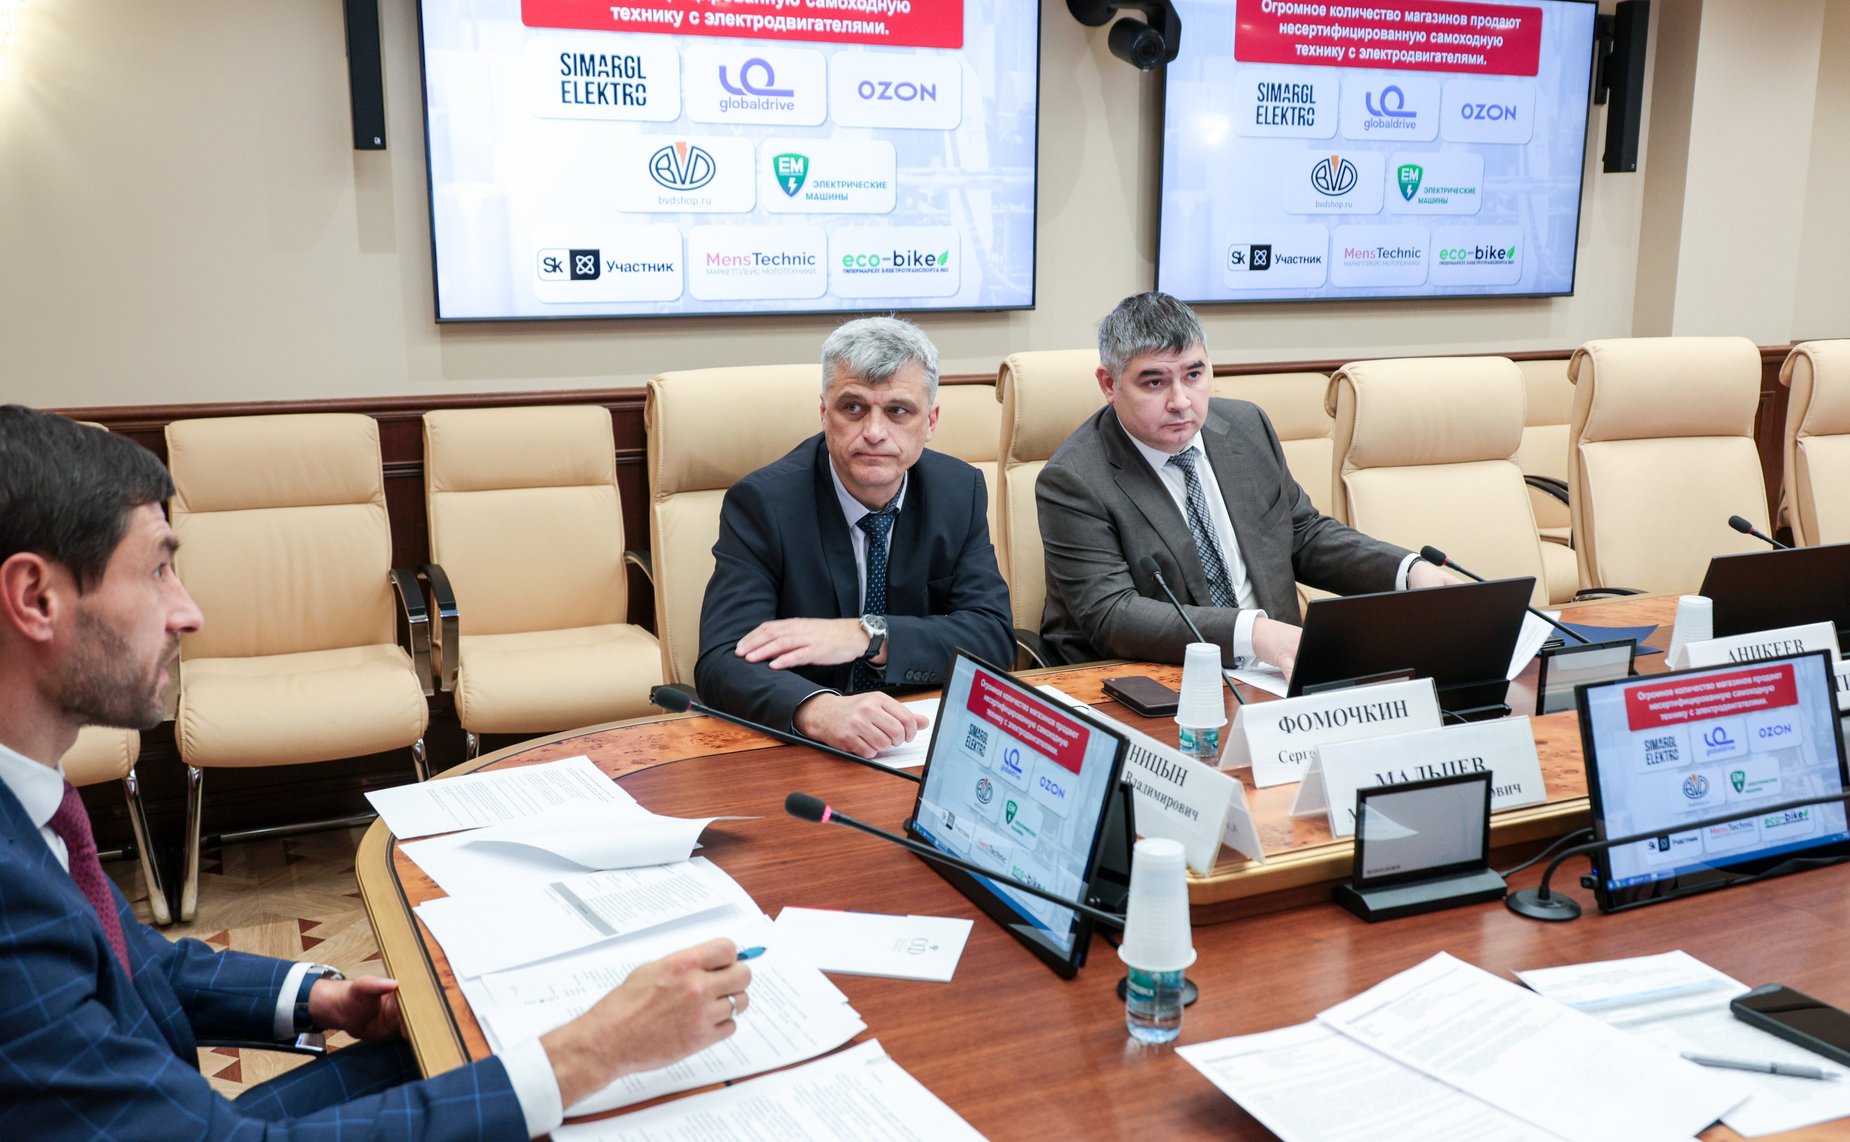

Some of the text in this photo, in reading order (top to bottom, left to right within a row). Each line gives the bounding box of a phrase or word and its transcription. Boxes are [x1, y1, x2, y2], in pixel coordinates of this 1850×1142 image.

[610, 6, 890, 35] технику с электродвигателями.
[1262, 0, 1521, 30] Огромное количество магазинов продают
[1279, 22, 1503, 48] несертифицированную самоходную
[1295, 43, 1487, 66] технику с электродвигателями.
[560, 52, 647, 79] SIMARGL
[561, 80, 647, 106] ELEKTRO
[858, 80, 936, 101] OZON
[1257, 82, 1316, 104] SIMARGL
[719, 97, 795, 112] globaldrive
[1461, 103, 1517, 121] OZON
[1256, 105, 1315, 126] ELEKTRO
[1364, 118, 1417, 131] globaldrive
[649, 145, 716, 190] BVD
[812, 180, 888, 189] ЭЛЕКТРИЧЕСКИЕ
[1311, 158, 1358, 196] BVD
[805, 192, 849, 201] МАШИНЫ
[1423, 187, 1476, 195] ЭЛЕКТРИЧЕСКИЕ
[658, 196, 712, 206] bvdshop.ru
[1315, 200, 1353, 209] bvdshop.ru
[1417, 197, 1449, 205] МАШИНЫ
[706, 252, 816, 266] MensTechnic
[842, 250, 936, 267] eco-bike
[1231, 252, 1246, 265] Sk
[1274, 254, 1322, 266] Участник
[1344, 247, 1421, 259] MensTechnic
[1439, 245, 1506, 260] eco-bike
[543, 257, 564, 273] Sk
[606, 260, 674, 273] Участник
[1728, 639, 1805, 663] АНИКЕЕВ
[1278, 700, 1408, 734] ФОМОЧКИН
[1759, 724, 1791, 738] OZON
[1128, 744, 1188, 787] НИЦЫН
[1040, 776, 1066, 799] OZON
[1125, 771, 1199, 821] Владимирович
